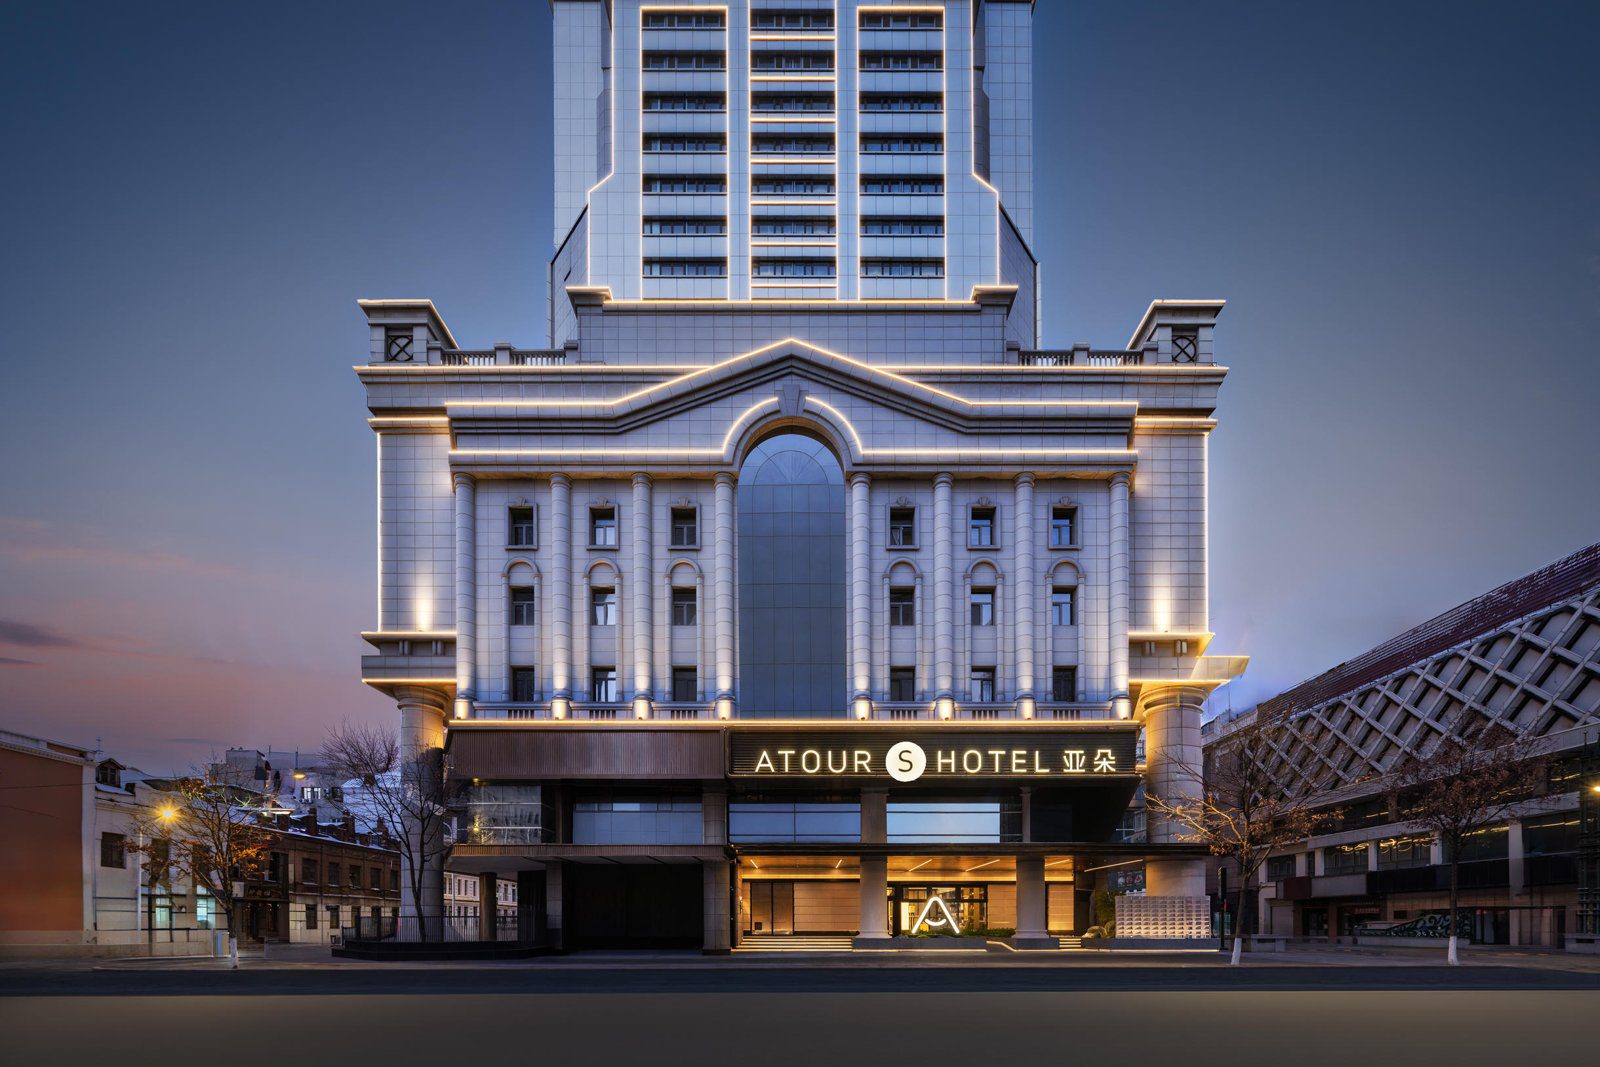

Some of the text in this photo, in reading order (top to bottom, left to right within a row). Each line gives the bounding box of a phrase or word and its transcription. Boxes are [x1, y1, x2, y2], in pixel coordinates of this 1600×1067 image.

[754, 749, 1117, 773] ATOUR S HOTEL 亚朵
